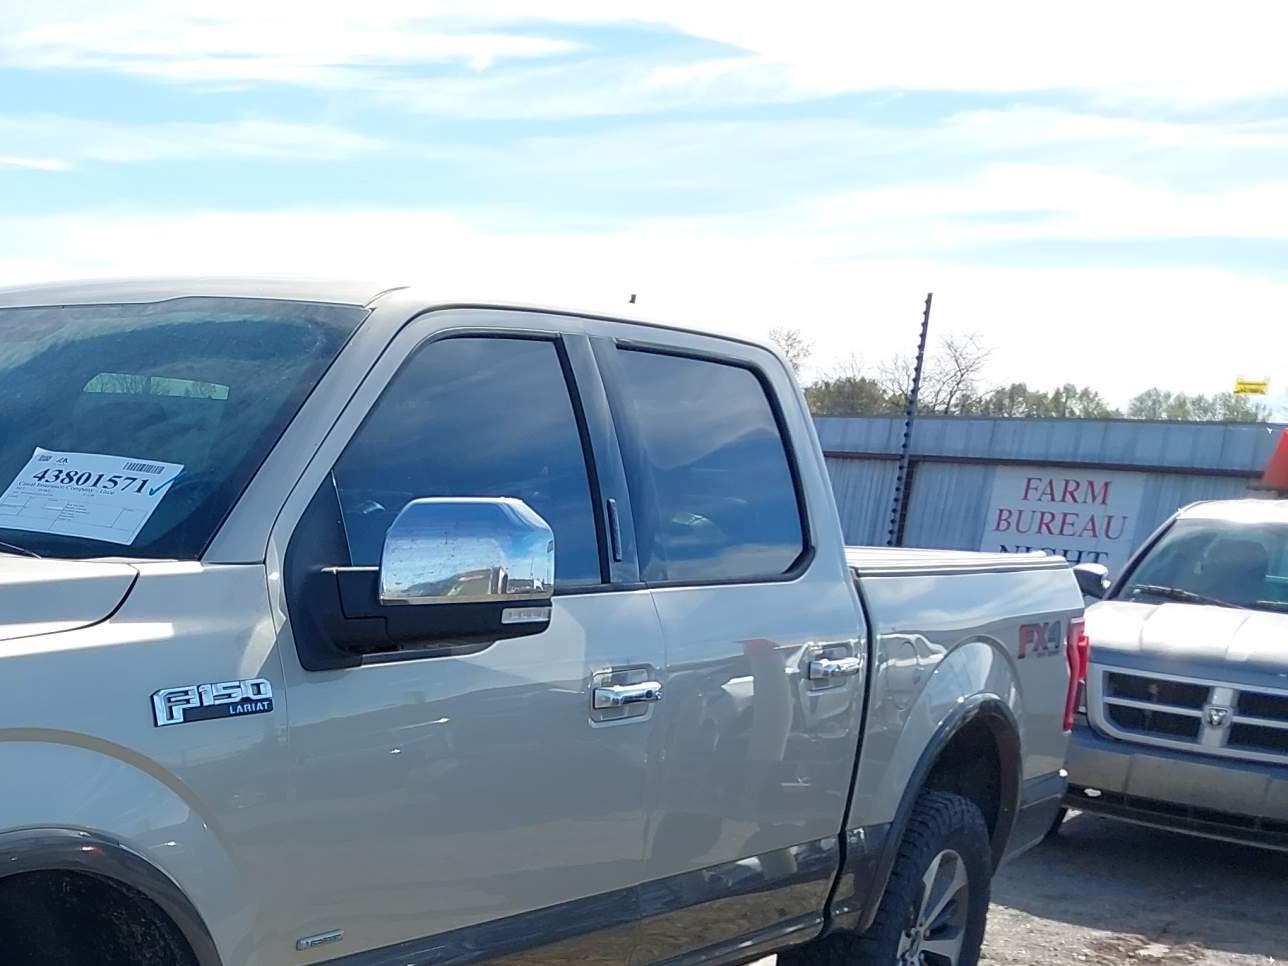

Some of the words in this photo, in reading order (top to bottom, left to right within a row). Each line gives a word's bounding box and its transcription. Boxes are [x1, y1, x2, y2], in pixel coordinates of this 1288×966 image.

[32, 468, 149, 494] 43801571
[1021, 476, 1113, 506] FARM
[992, 508, 1129, 541] BUREAU
[1017, 621, 1061, 659] FX4
[229, 701, 270, 714] LARIAT
